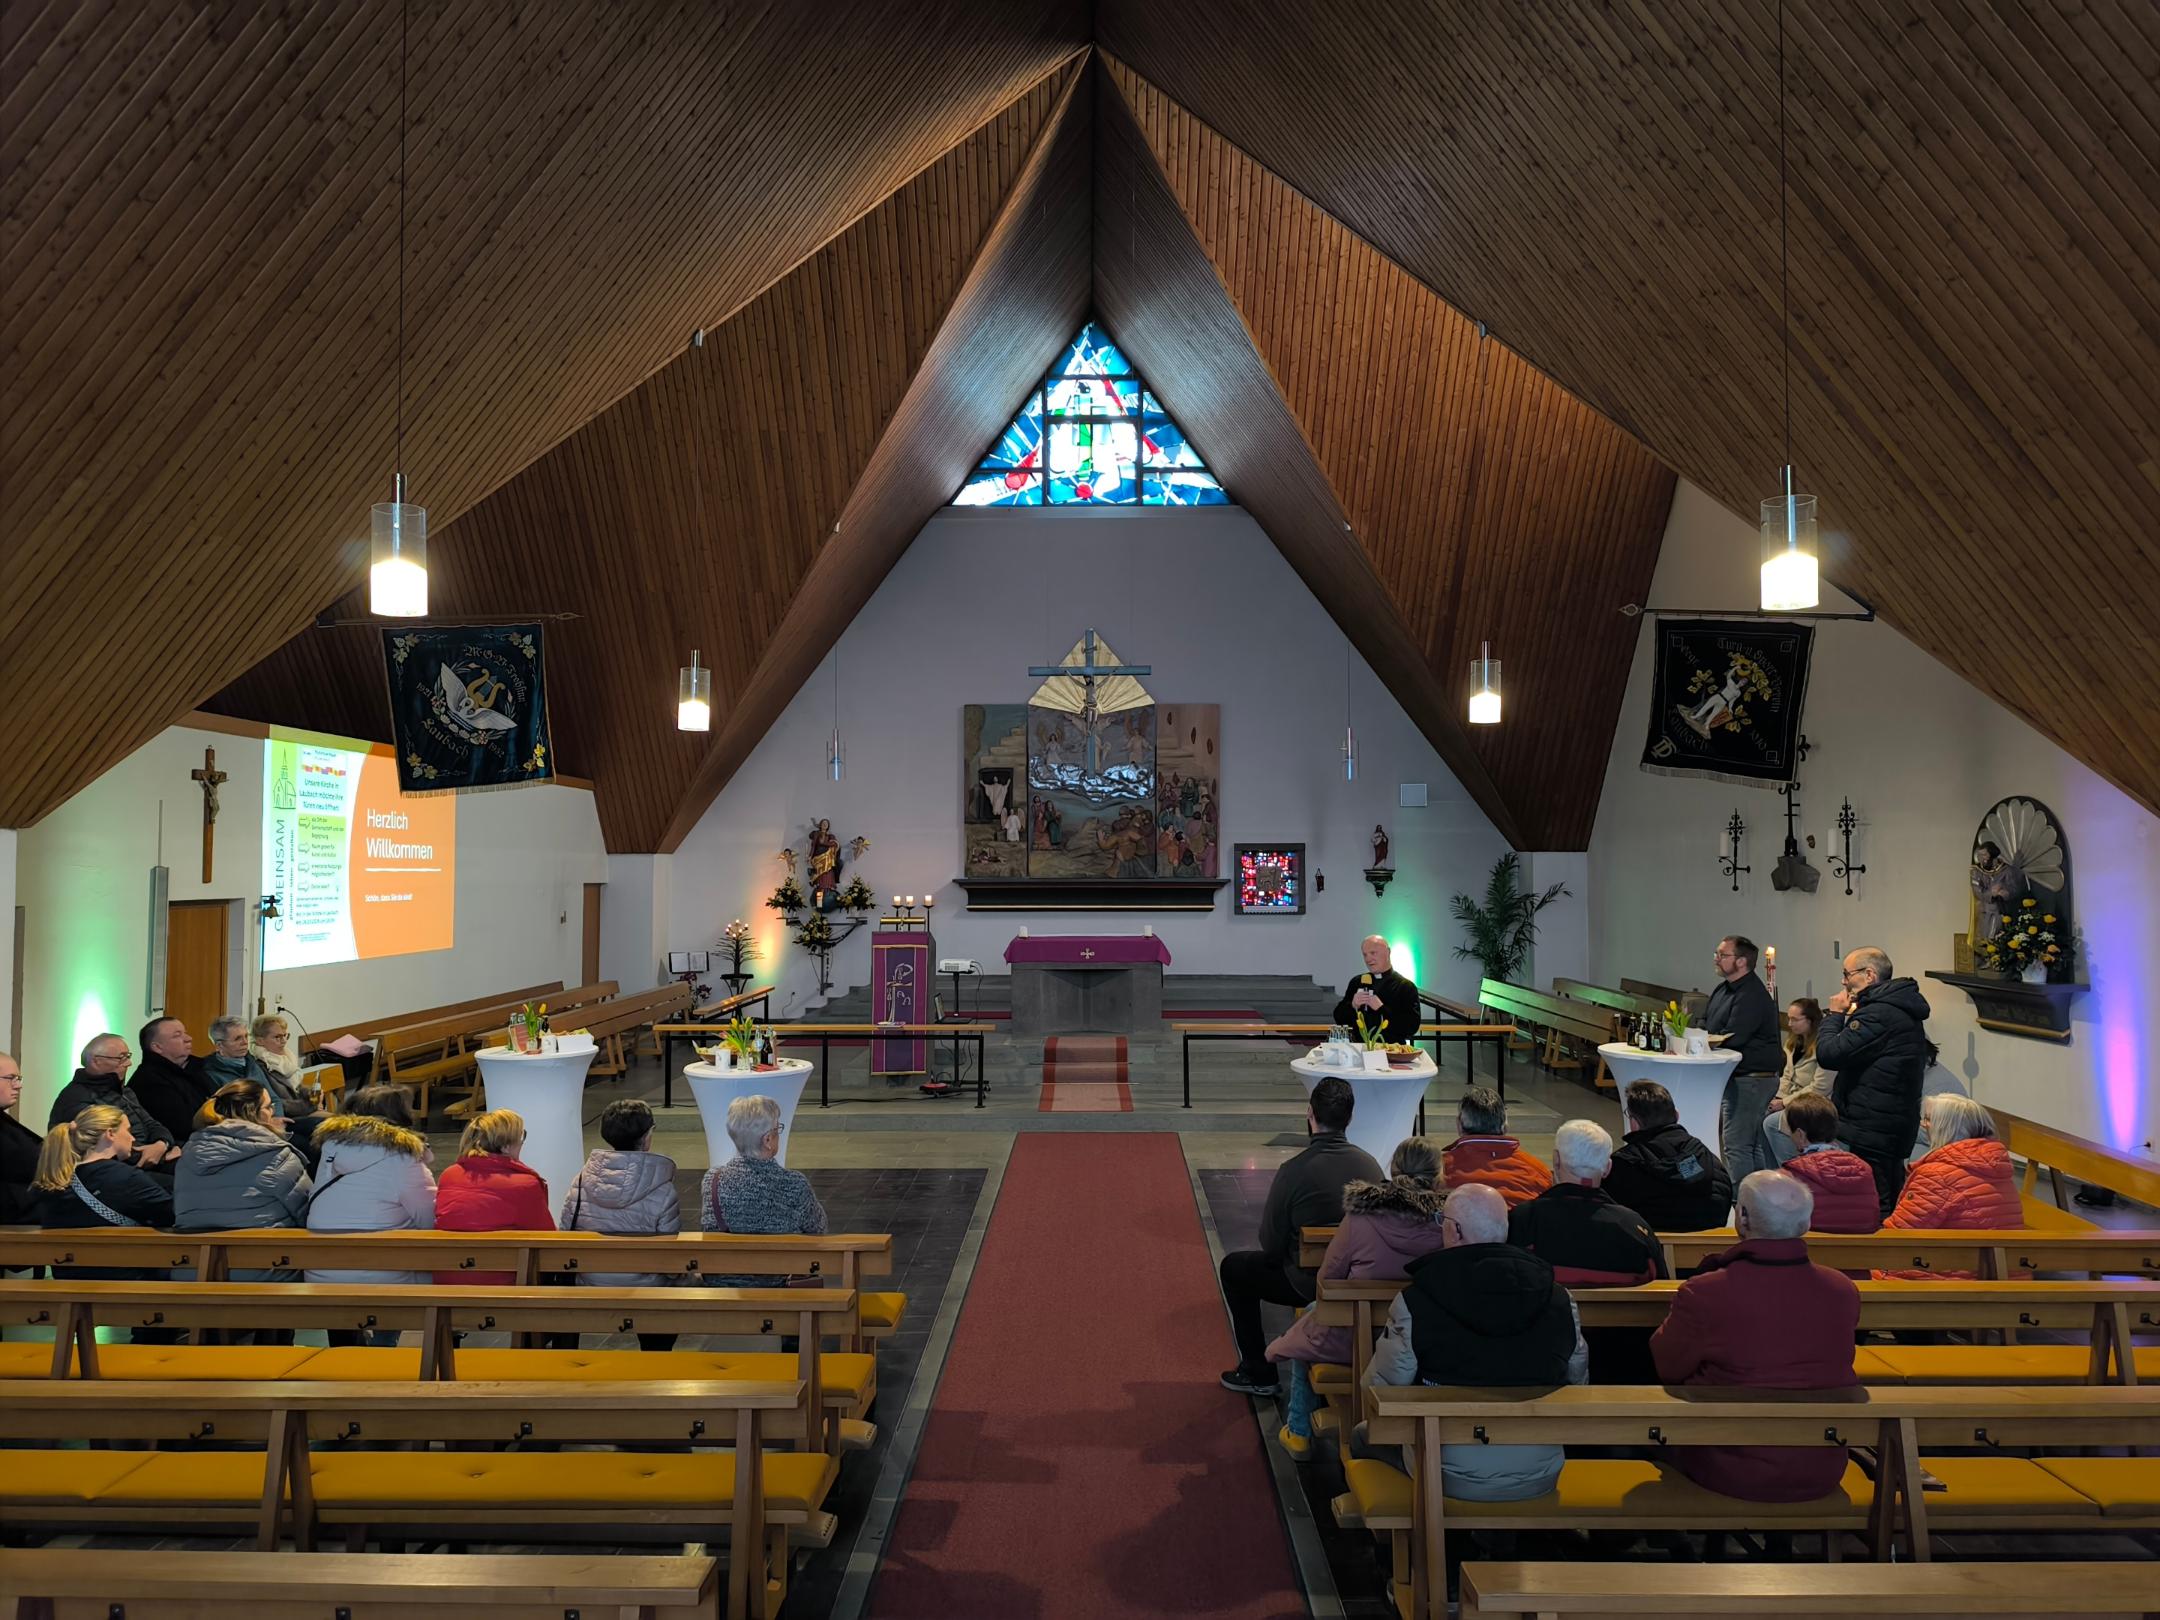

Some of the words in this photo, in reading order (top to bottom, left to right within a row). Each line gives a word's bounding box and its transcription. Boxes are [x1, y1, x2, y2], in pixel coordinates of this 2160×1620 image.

[367, 808, 408, 830] Herzlich
[366, 837, 433, 860] Willkommen
[275, 819, 285, 932] GEMEINSAM
